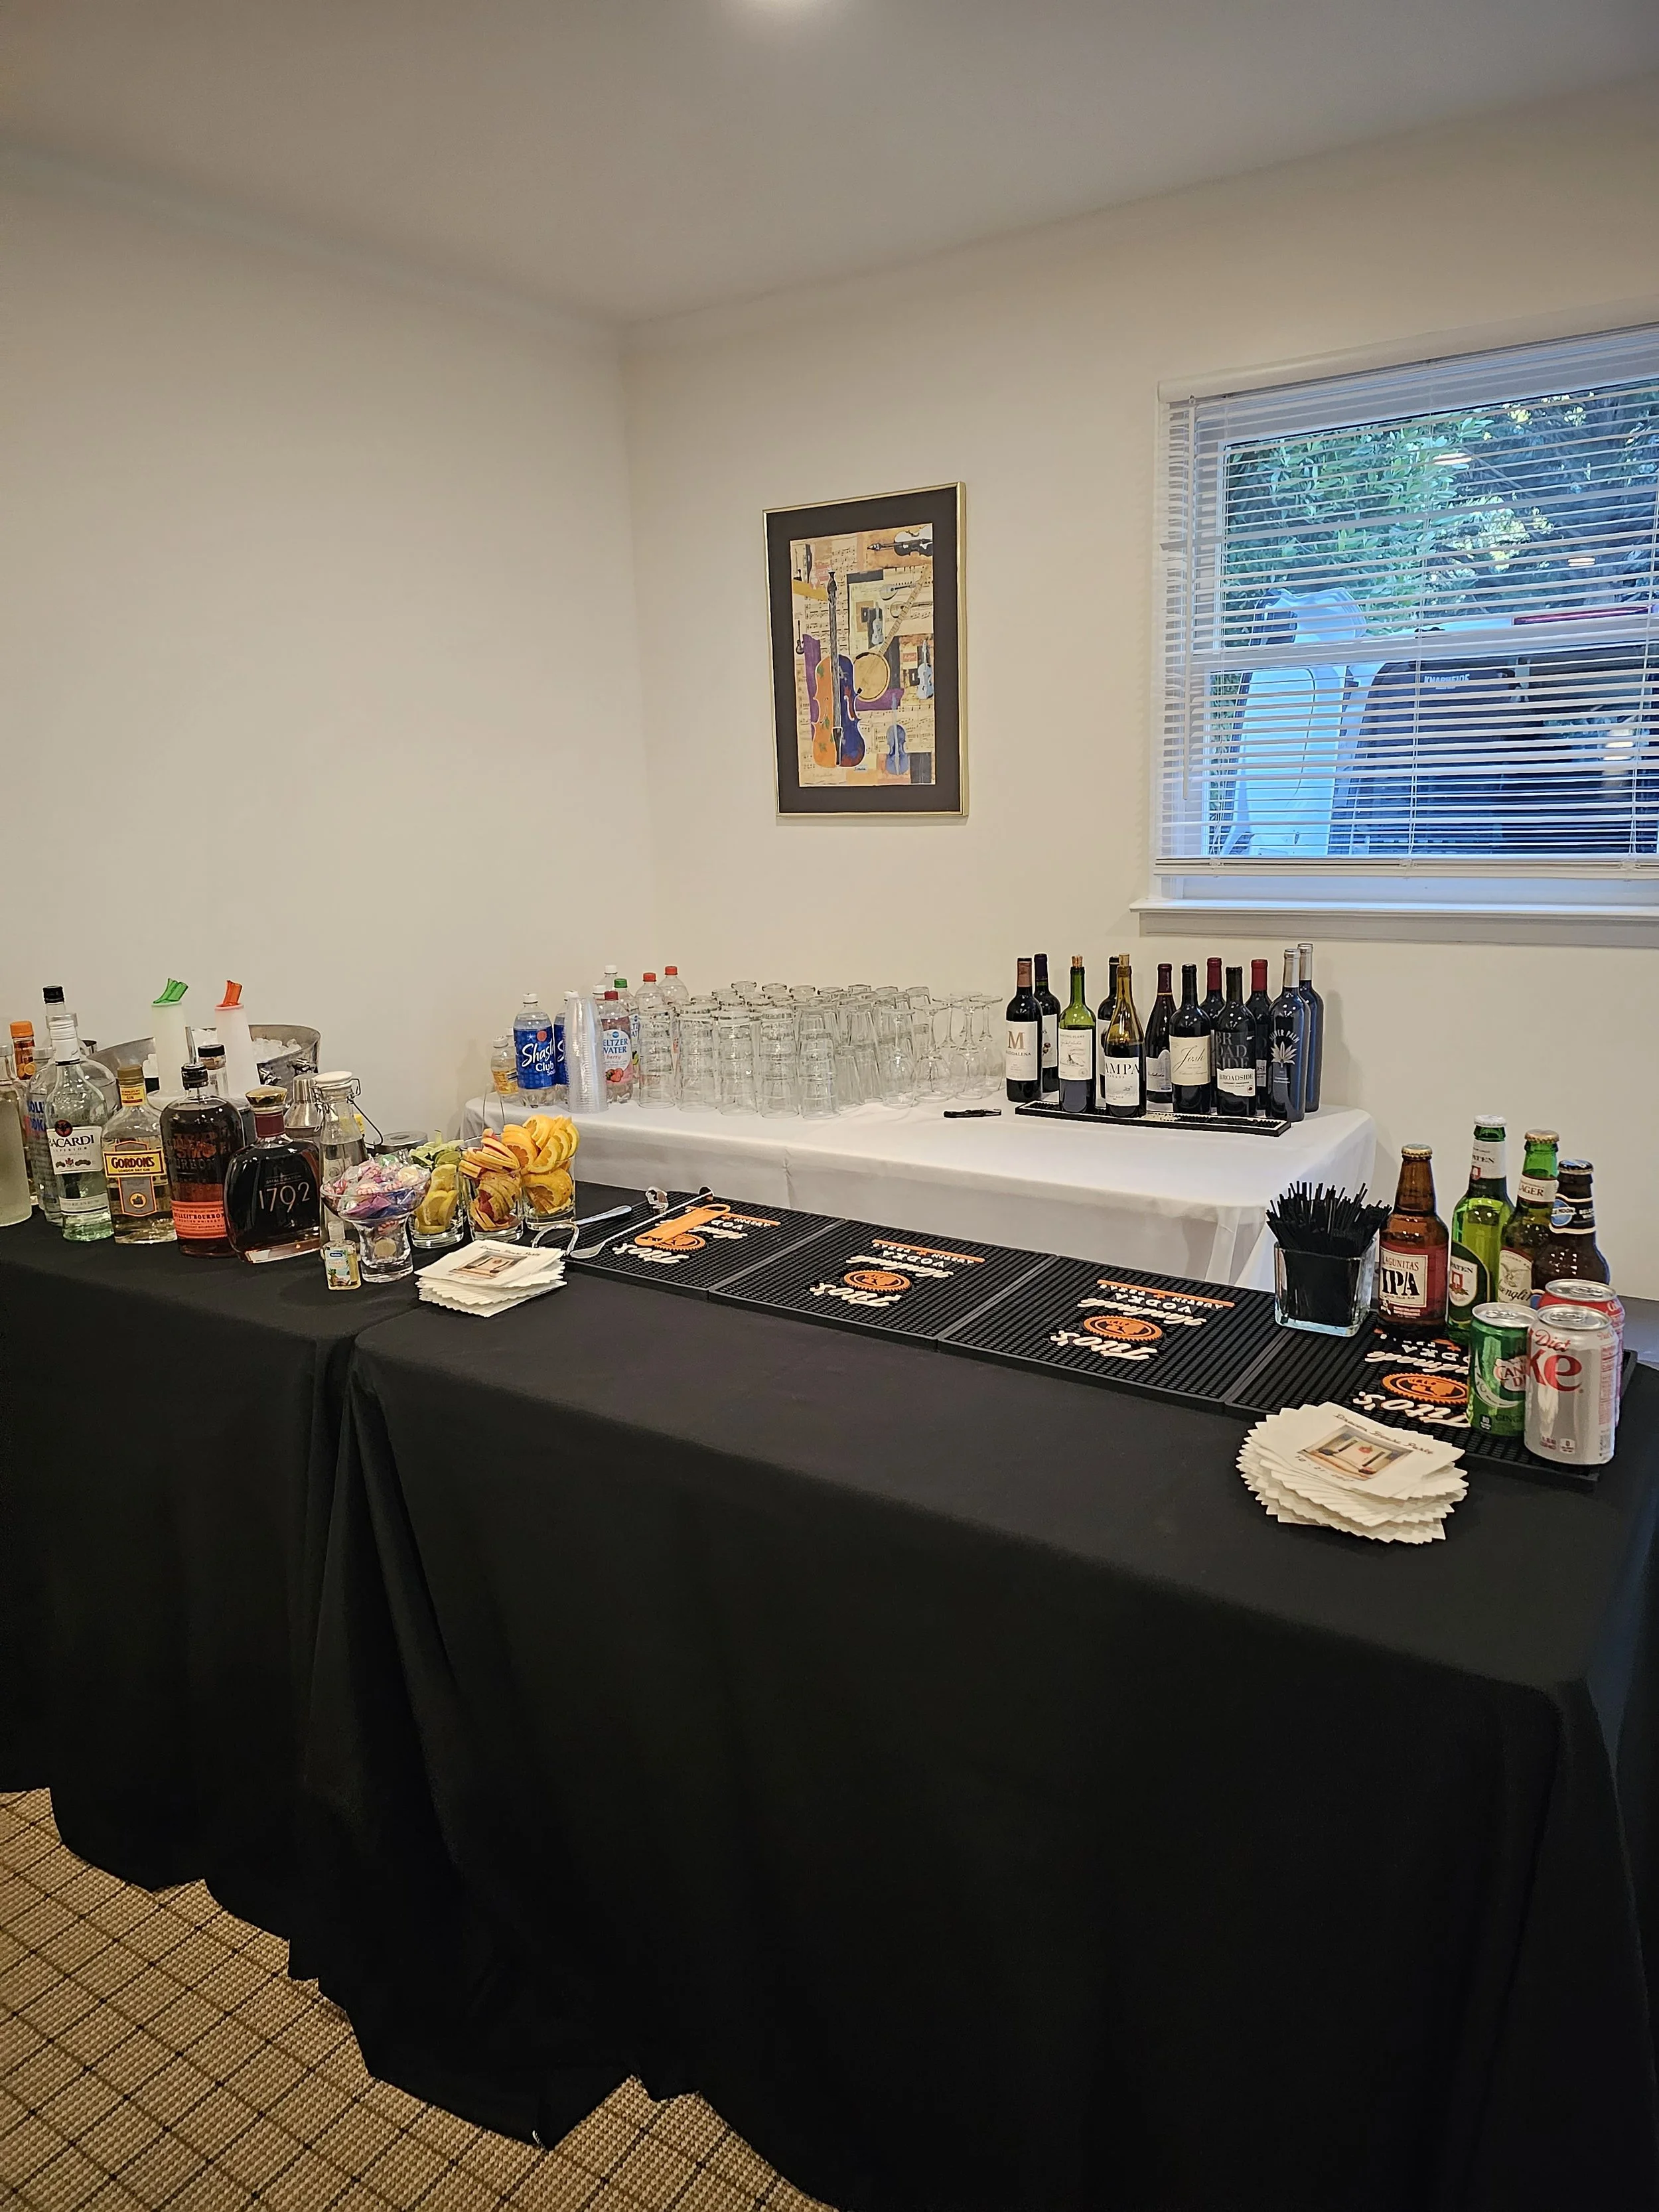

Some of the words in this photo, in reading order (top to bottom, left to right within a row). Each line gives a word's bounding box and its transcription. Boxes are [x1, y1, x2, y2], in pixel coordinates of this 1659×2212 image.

[603, 1038, 628, 1047] ELTZER
[1008, 1031, 1025, 1049] M
[536, 1061, 554, 1072] Club
[1173, 1045, 1206, 1073] Josh
[48, 1134, 94, 1148] BACARDI
[111, 1155, 155, 1169] GORDON'S
[1472, 1155, 1494, 1164] ATEN
[259, 1182, 310, 1213] 1792
[882, 1250, 946, 1268] VODKA
[1382, 1251, 1419, 1272] LAGUNITAS
[1382, 1267, 1420, 1296] IPA
[810, 1282, 902, 1307] Tito's
[1114, 1292, 1193, 1314] VODKA
[1076, 1297, 1207, 1327] Handmade
[1050, 1330, 1158, 1361] Tito's
[1535, 1329, 1571, 1353] Diet
[1527, 1328, 1583, 1392] ke
[1352, 1391, 1472, 1428] Tito's
